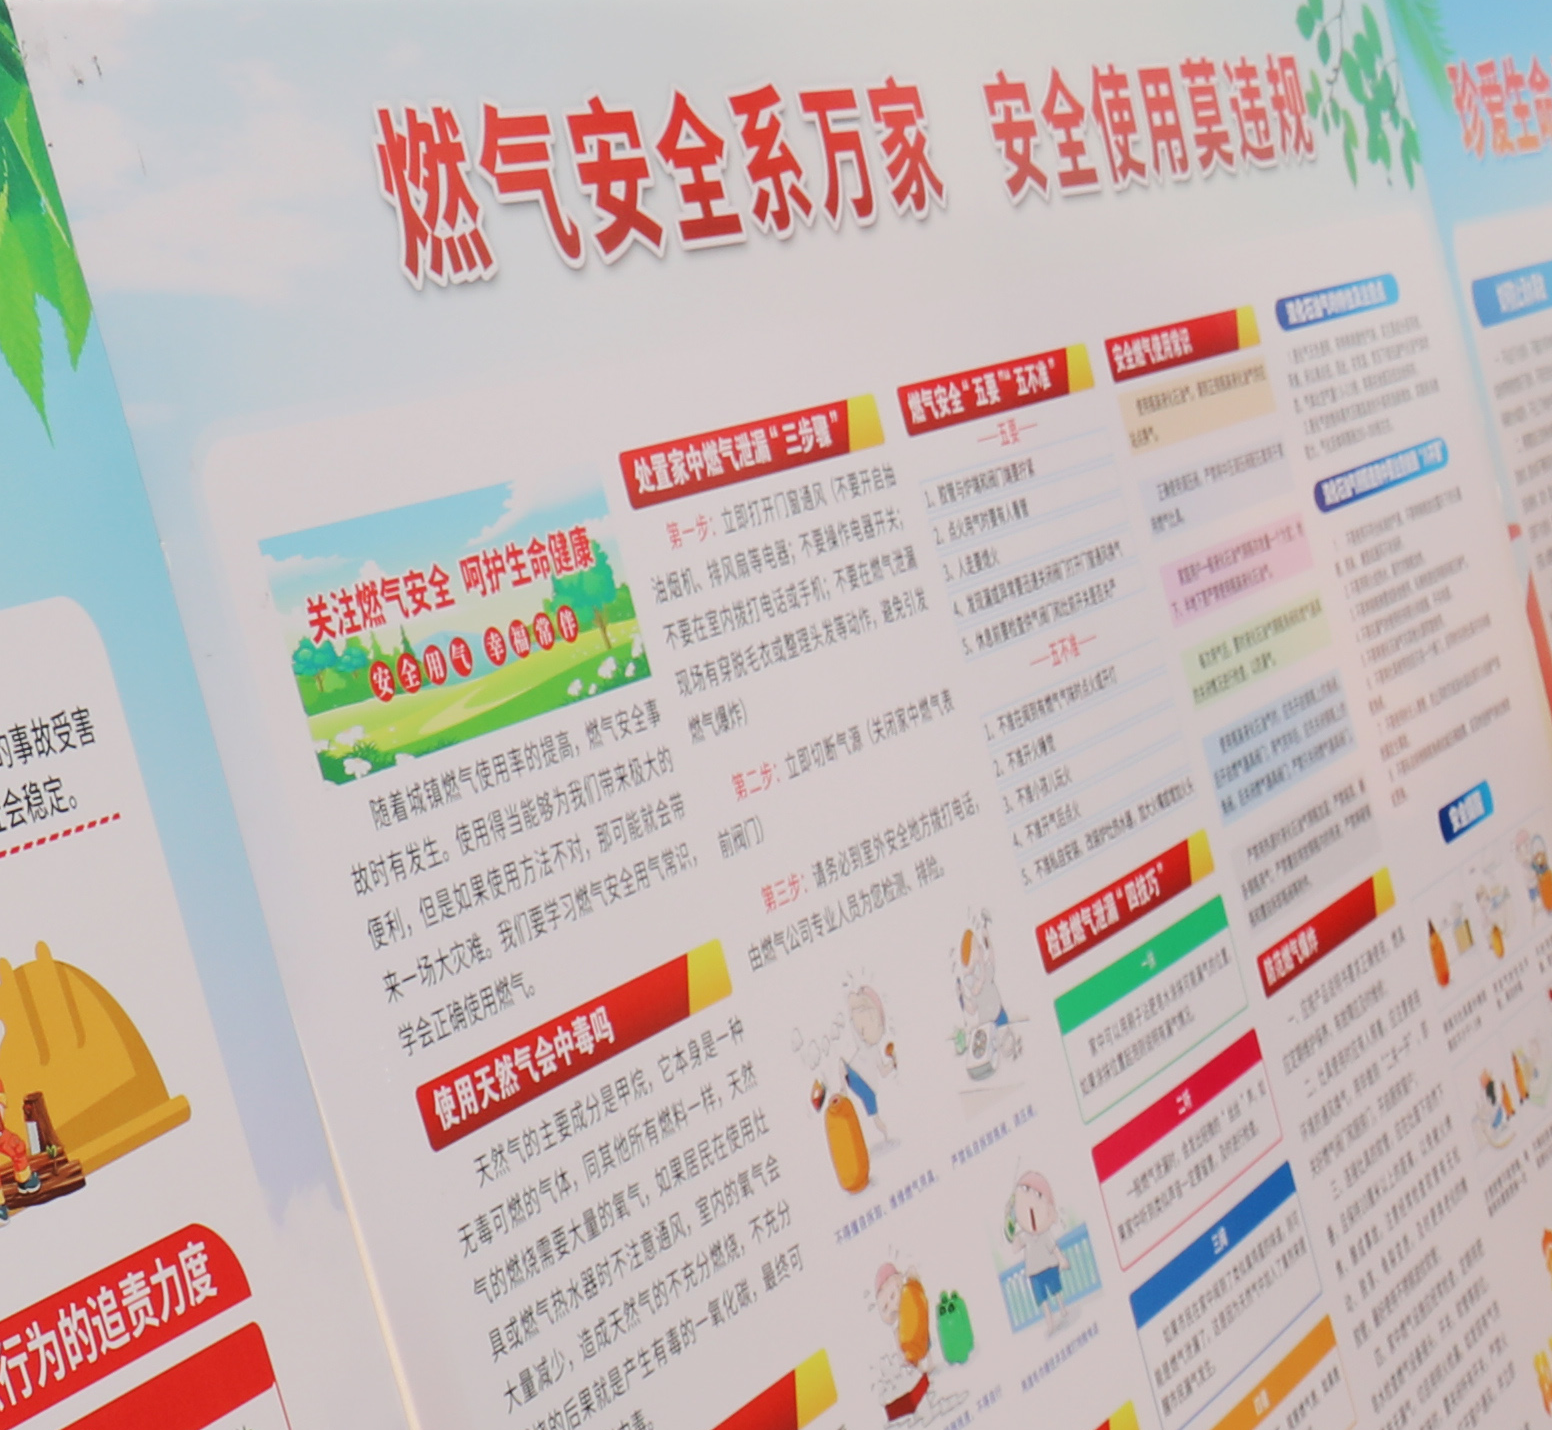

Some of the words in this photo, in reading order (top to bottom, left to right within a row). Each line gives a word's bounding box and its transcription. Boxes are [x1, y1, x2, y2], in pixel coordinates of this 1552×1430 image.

[375, 76, 947, 285] 燃气安全系万家
[982, 53, 1318, 199] 安全使用莫违规
[303, 561, 456, 646] 关注燃气安全
[459, 524, 596, 600] 呵护生命健康
[371, 637, 473, 702] 安全用气
[484, 607, 580, 667] 幸福常伴
[0, 771, 79, 833] 会稳定。
[349, 745, 676, 898] 故时有发生。使用得当能够为我们带来极大的
[368, 698, 663, 829] 随着城镇燃气使用率的提高，燃气安全事
[364, 792, 688, 951] 便利，但是如果使用方法不对，那可能就会带
[379, 839, 700, 1006] 来一场大灾难。我们要学习燃气安全用气常识，
[395, 965, 538, 1059] 学会正确使用燃气。
[429, 1003, 617, 1133] 使用天然气会中毒吗
[454, 1059, 760, 1259] 无毒可燃的气体，同其他所有燃料一样，天然
[470, 1014, 747, 1189] 天然气的主要成分是甲烷，它本身是一种
[469, 1106, 771, 1311] 气的燃烧需要大量的氧气，如果居民在使用灶
[484, 1150, 783, 1363] 具或燃气热水器时不注意通风，室内的氧气会
[0, 1235, 220, 1414] 行为的追责力度
[498, 1196, 795, 1416] 大量减少，造成天然气的不充分燃烧，不充分
